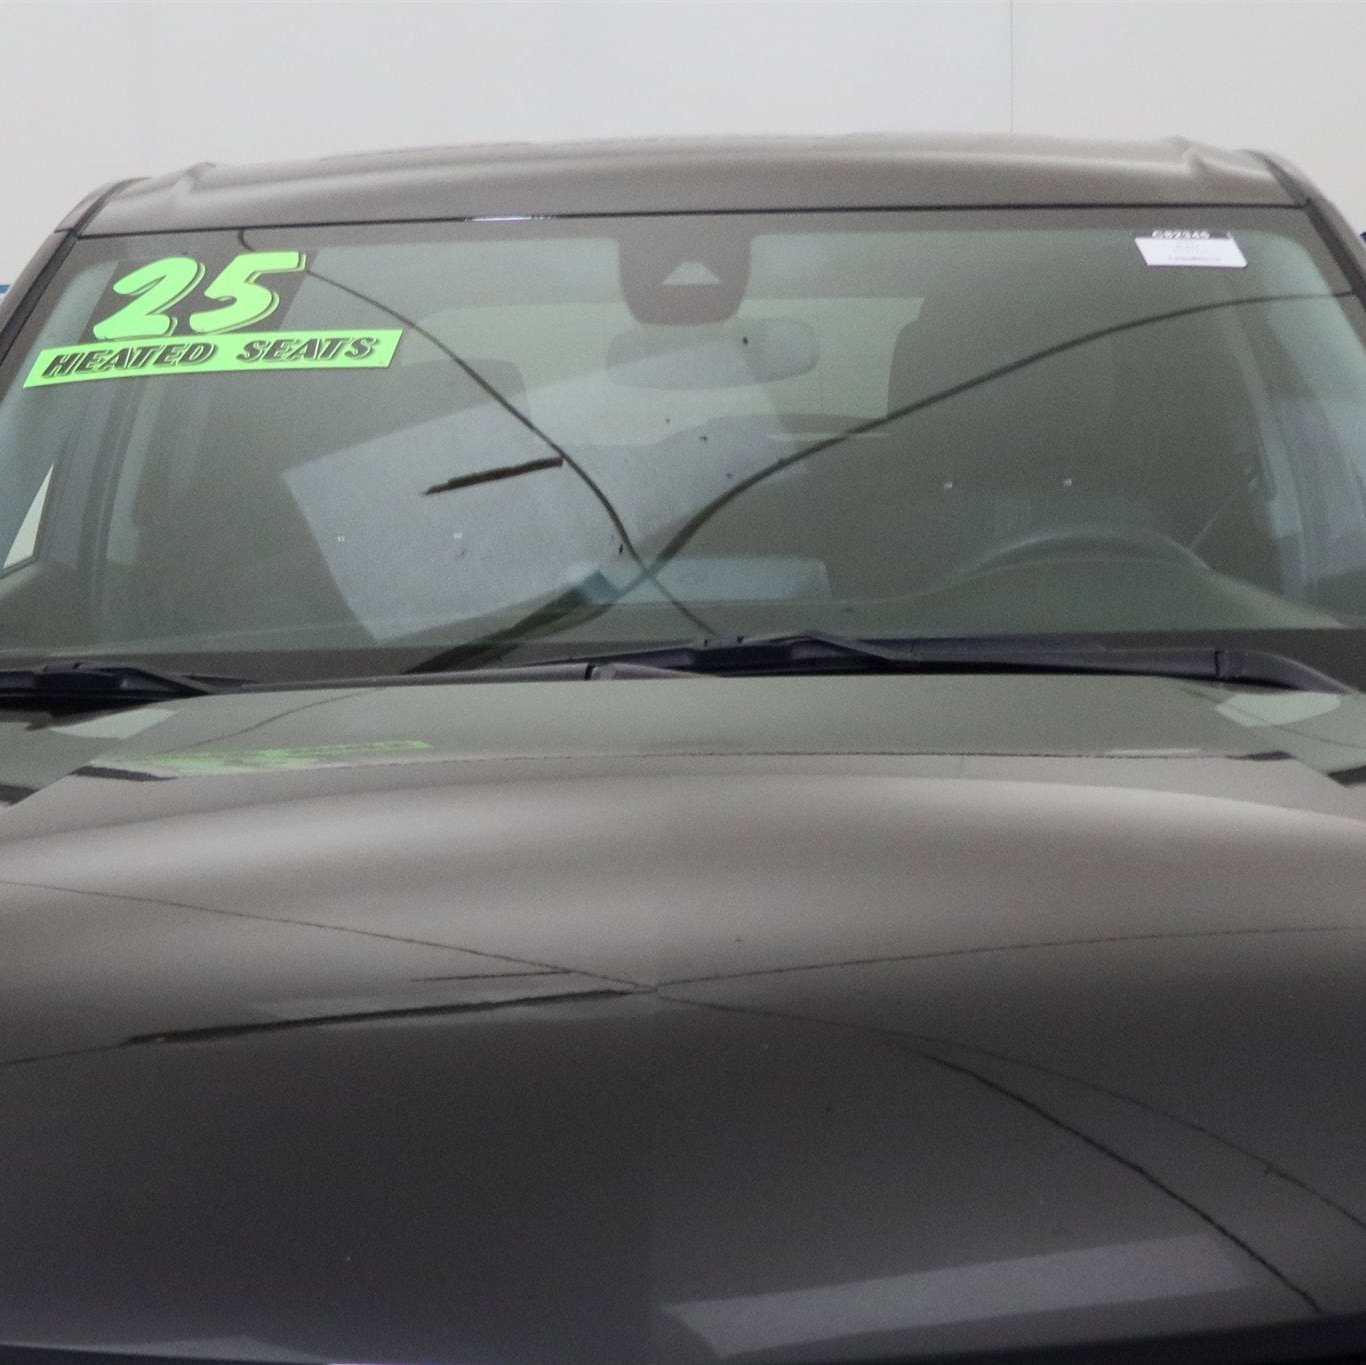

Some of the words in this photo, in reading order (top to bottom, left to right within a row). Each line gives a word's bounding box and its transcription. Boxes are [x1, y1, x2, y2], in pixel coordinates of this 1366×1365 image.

[93, 251, 306, 340] 25
[42, 342, 218, 378] HEATED
[236, 339, 378, 364] SEATS
